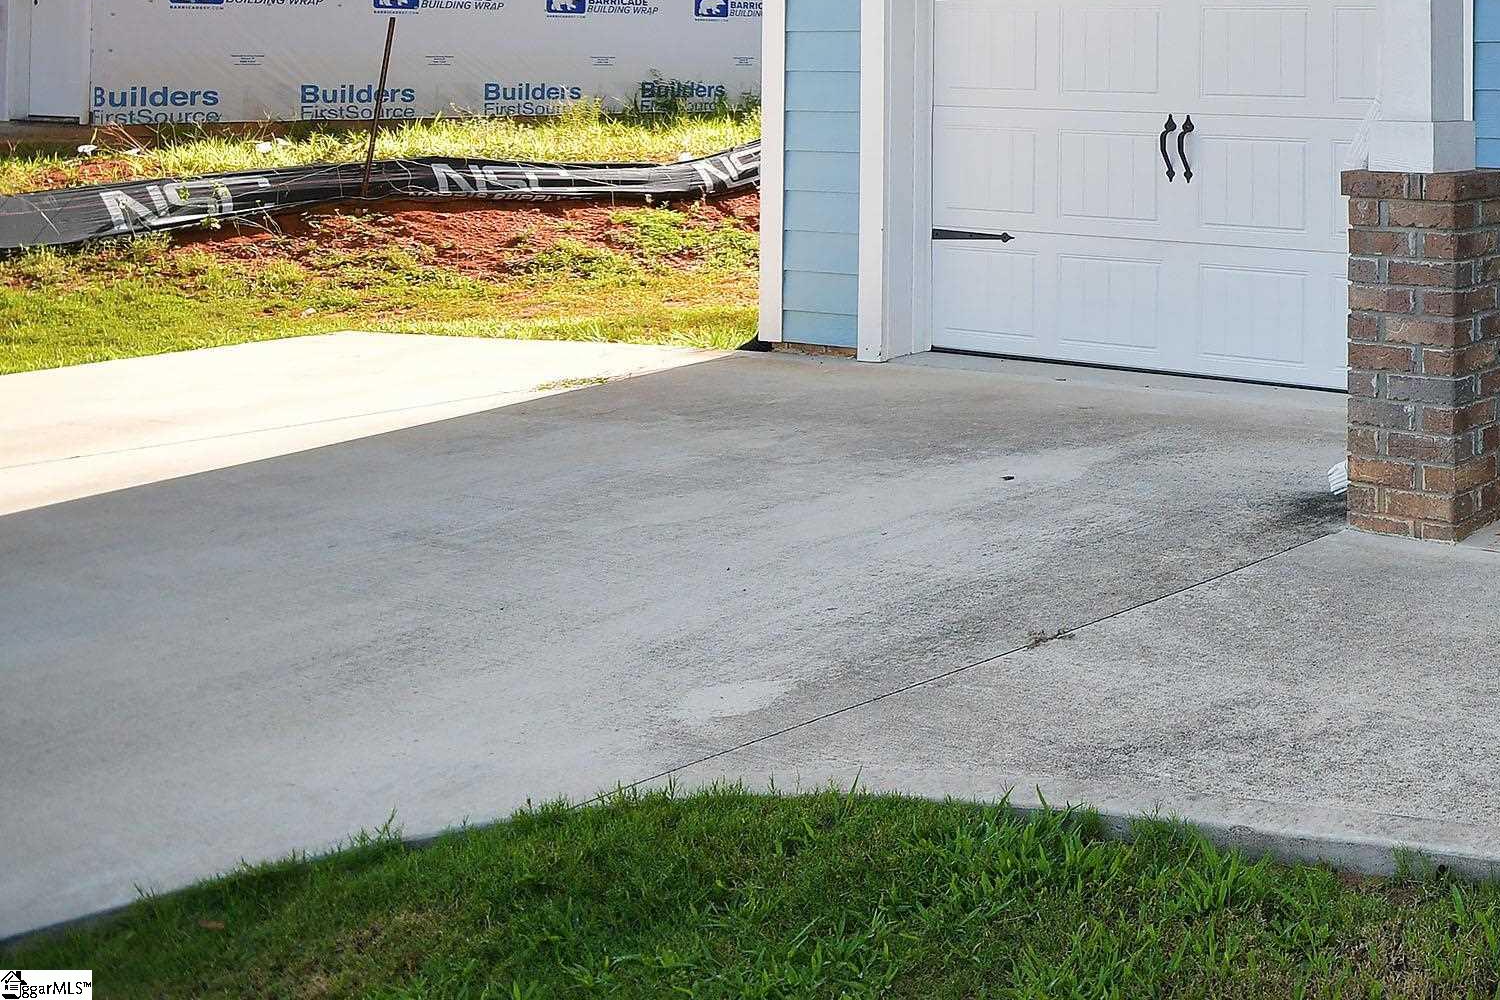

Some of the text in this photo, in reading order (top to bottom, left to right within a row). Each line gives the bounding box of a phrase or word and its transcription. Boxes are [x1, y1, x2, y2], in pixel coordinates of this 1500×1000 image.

[421, 0, 505, 11] BUILDING WRAP
[587, 5, 659, 15] BUILDING WRAP
[94, 86, 219, 107] Builders
[300, 84, 416, 103] Builders
[484, 102, 562, 116] FirstSou
